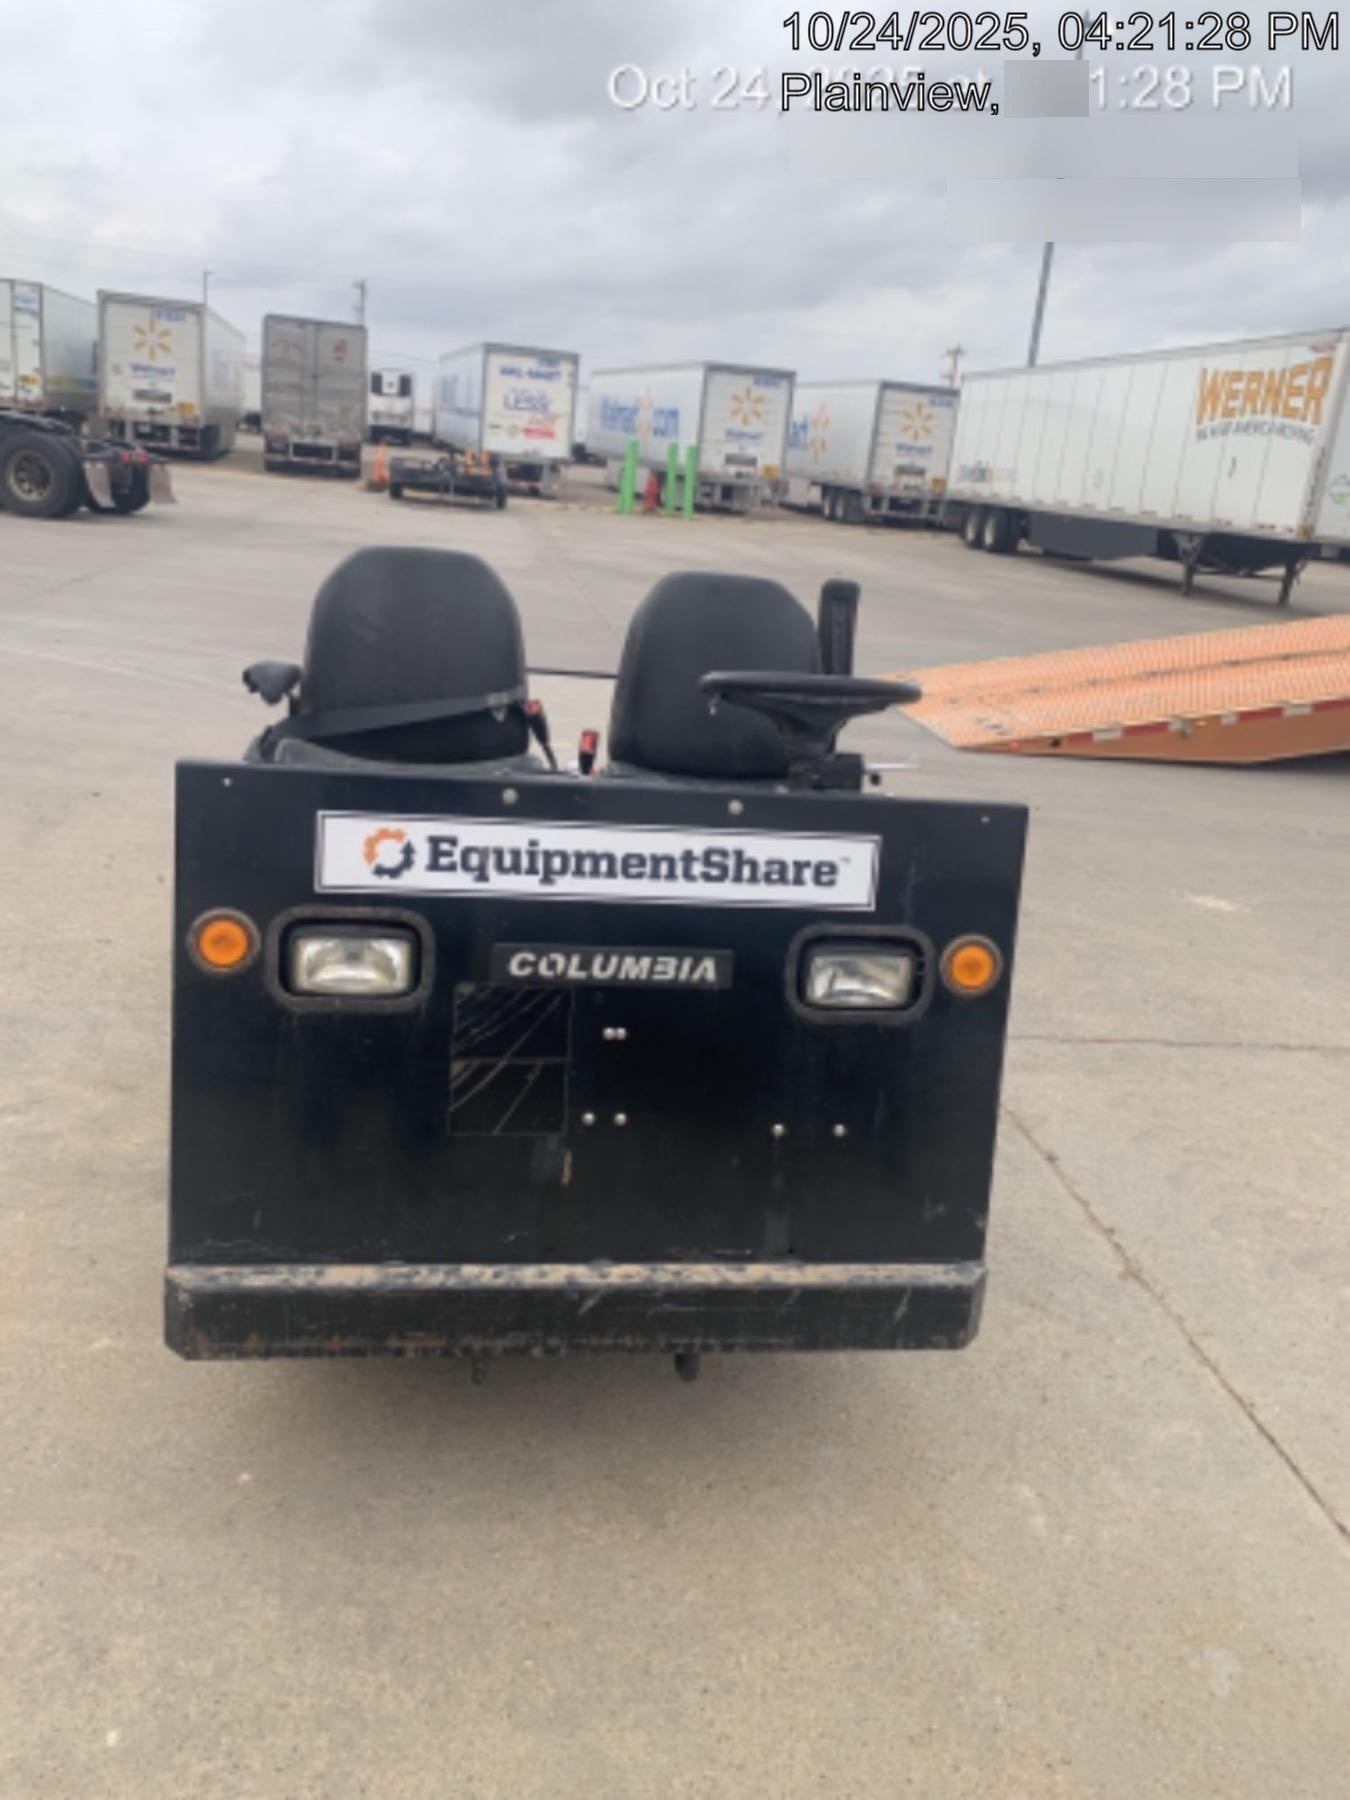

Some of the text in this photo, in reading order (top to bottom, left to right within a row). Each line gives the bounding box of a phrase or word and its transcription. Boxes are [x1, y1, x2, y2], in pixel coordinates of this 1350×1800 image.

[1197, 357, 1334, 425] WERNER
[426, 836, 838, 888] EquipmentShare
[508, 951, 718, 983] COLUMBIA
